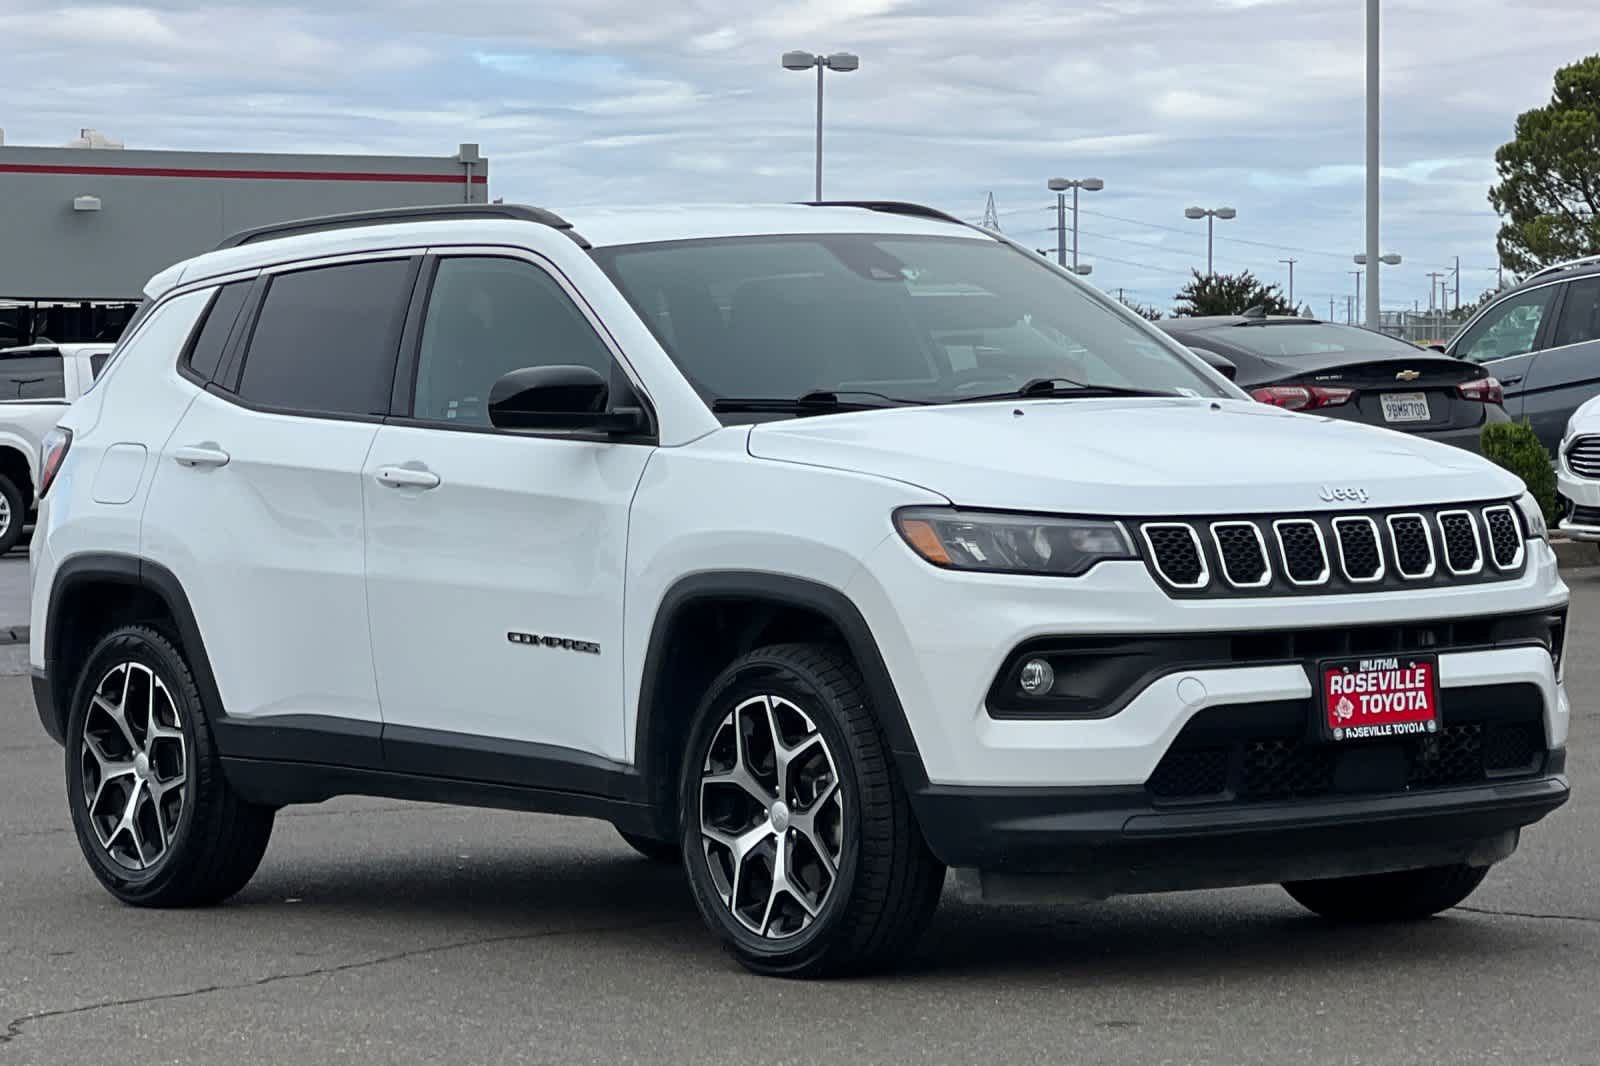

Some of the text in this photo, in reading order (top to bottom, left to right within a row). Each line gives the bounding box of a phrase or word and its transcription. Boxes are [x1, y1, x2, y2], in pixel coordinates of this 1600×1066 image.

[1319, 485, 1369, 504] Jeep
[507, 631, 601, 655] COMPASS
[1369, 658, 1398, 671] LITHIA
[1330, 669, 1425, 695] ROSEVILLE
[1360, 690, 1428, 714] TOYOTA
[1345, 724, 1392, 739] ROSEVILLE
